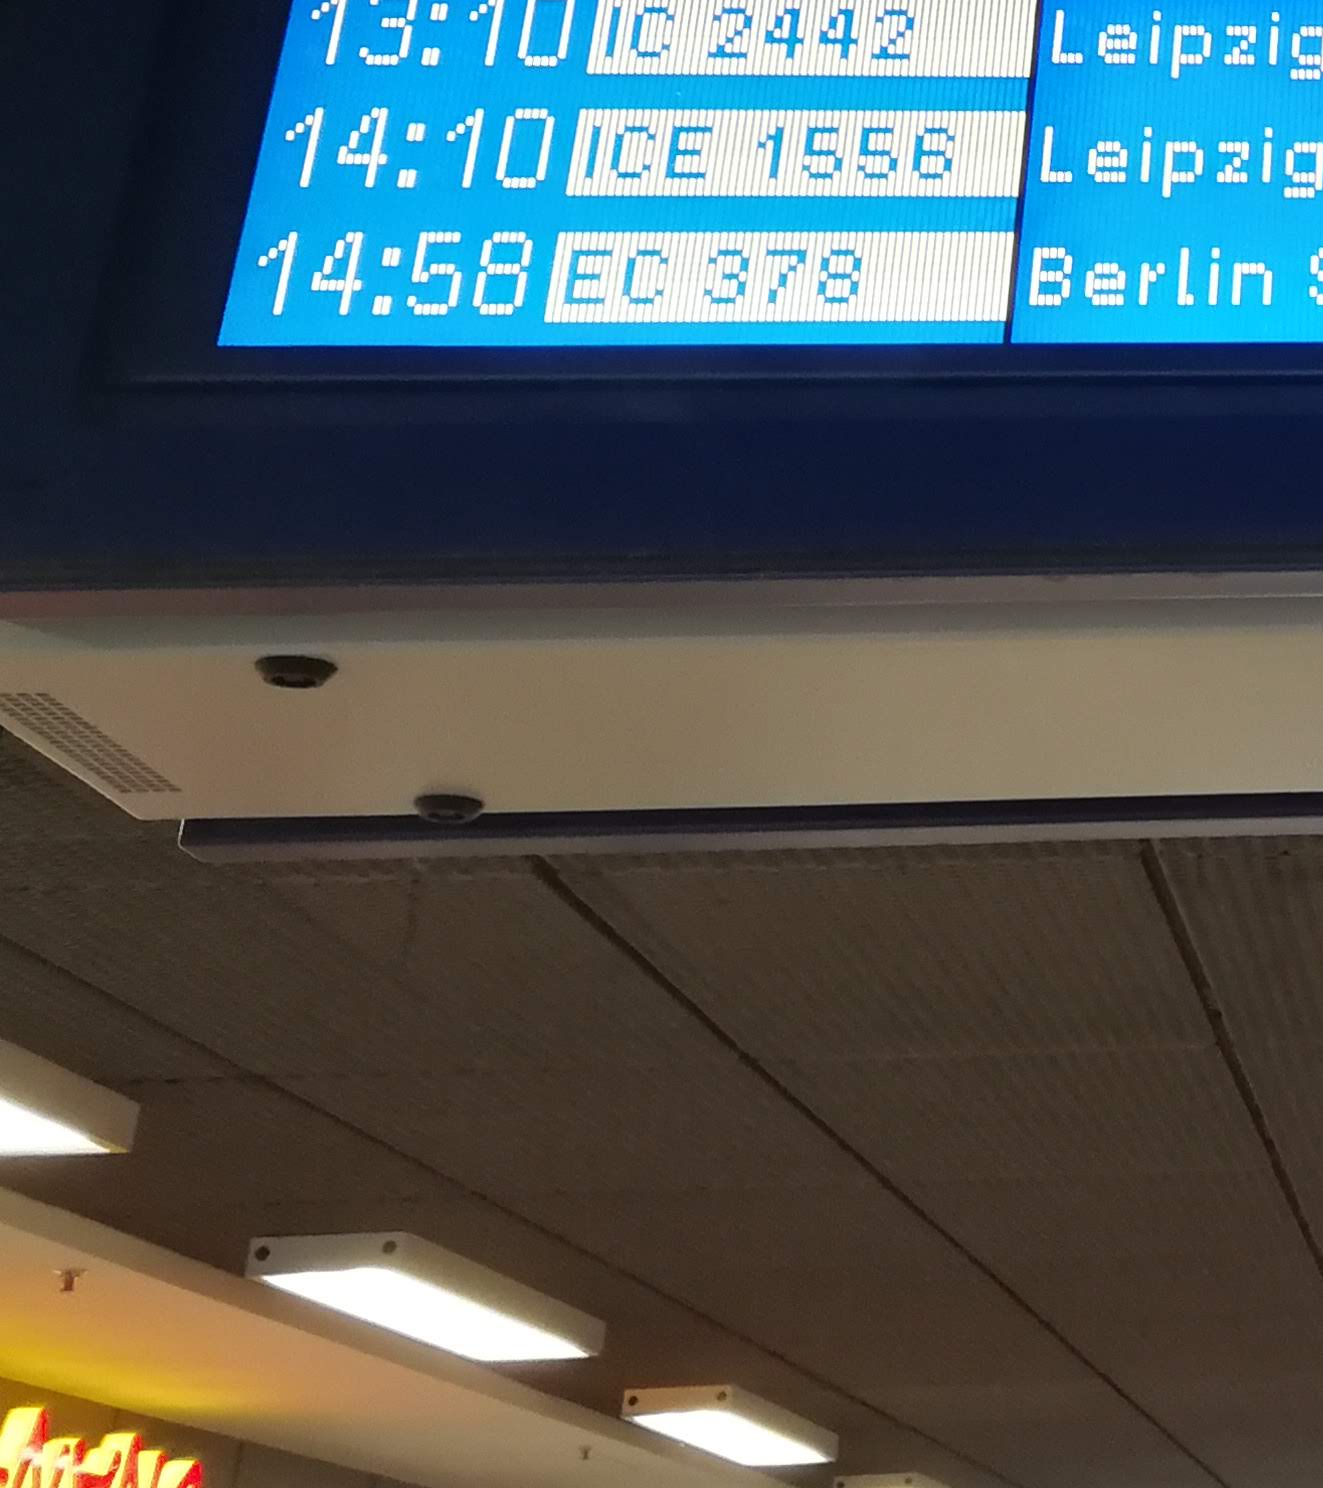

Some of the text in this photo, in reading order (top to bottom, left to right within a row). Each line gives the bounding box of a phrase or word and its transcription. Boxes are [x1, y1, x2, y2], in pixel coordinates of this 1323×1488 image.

[602, 3, 672, 69] IC
[708, 6, 916, 61] 2442
[286, 108, 554, 188] 14:10
[580, 122, 713, 185] ICE
[754, 124, 957, 182] 1556
[1041, 127, 1323, 198] Leipzig
[259, 232, 532, 315] 14:58
[564, 247, 669, 306] EC
[701, 247, 862, 306] 378
[1029, 248, 1272, 305] Berlin
